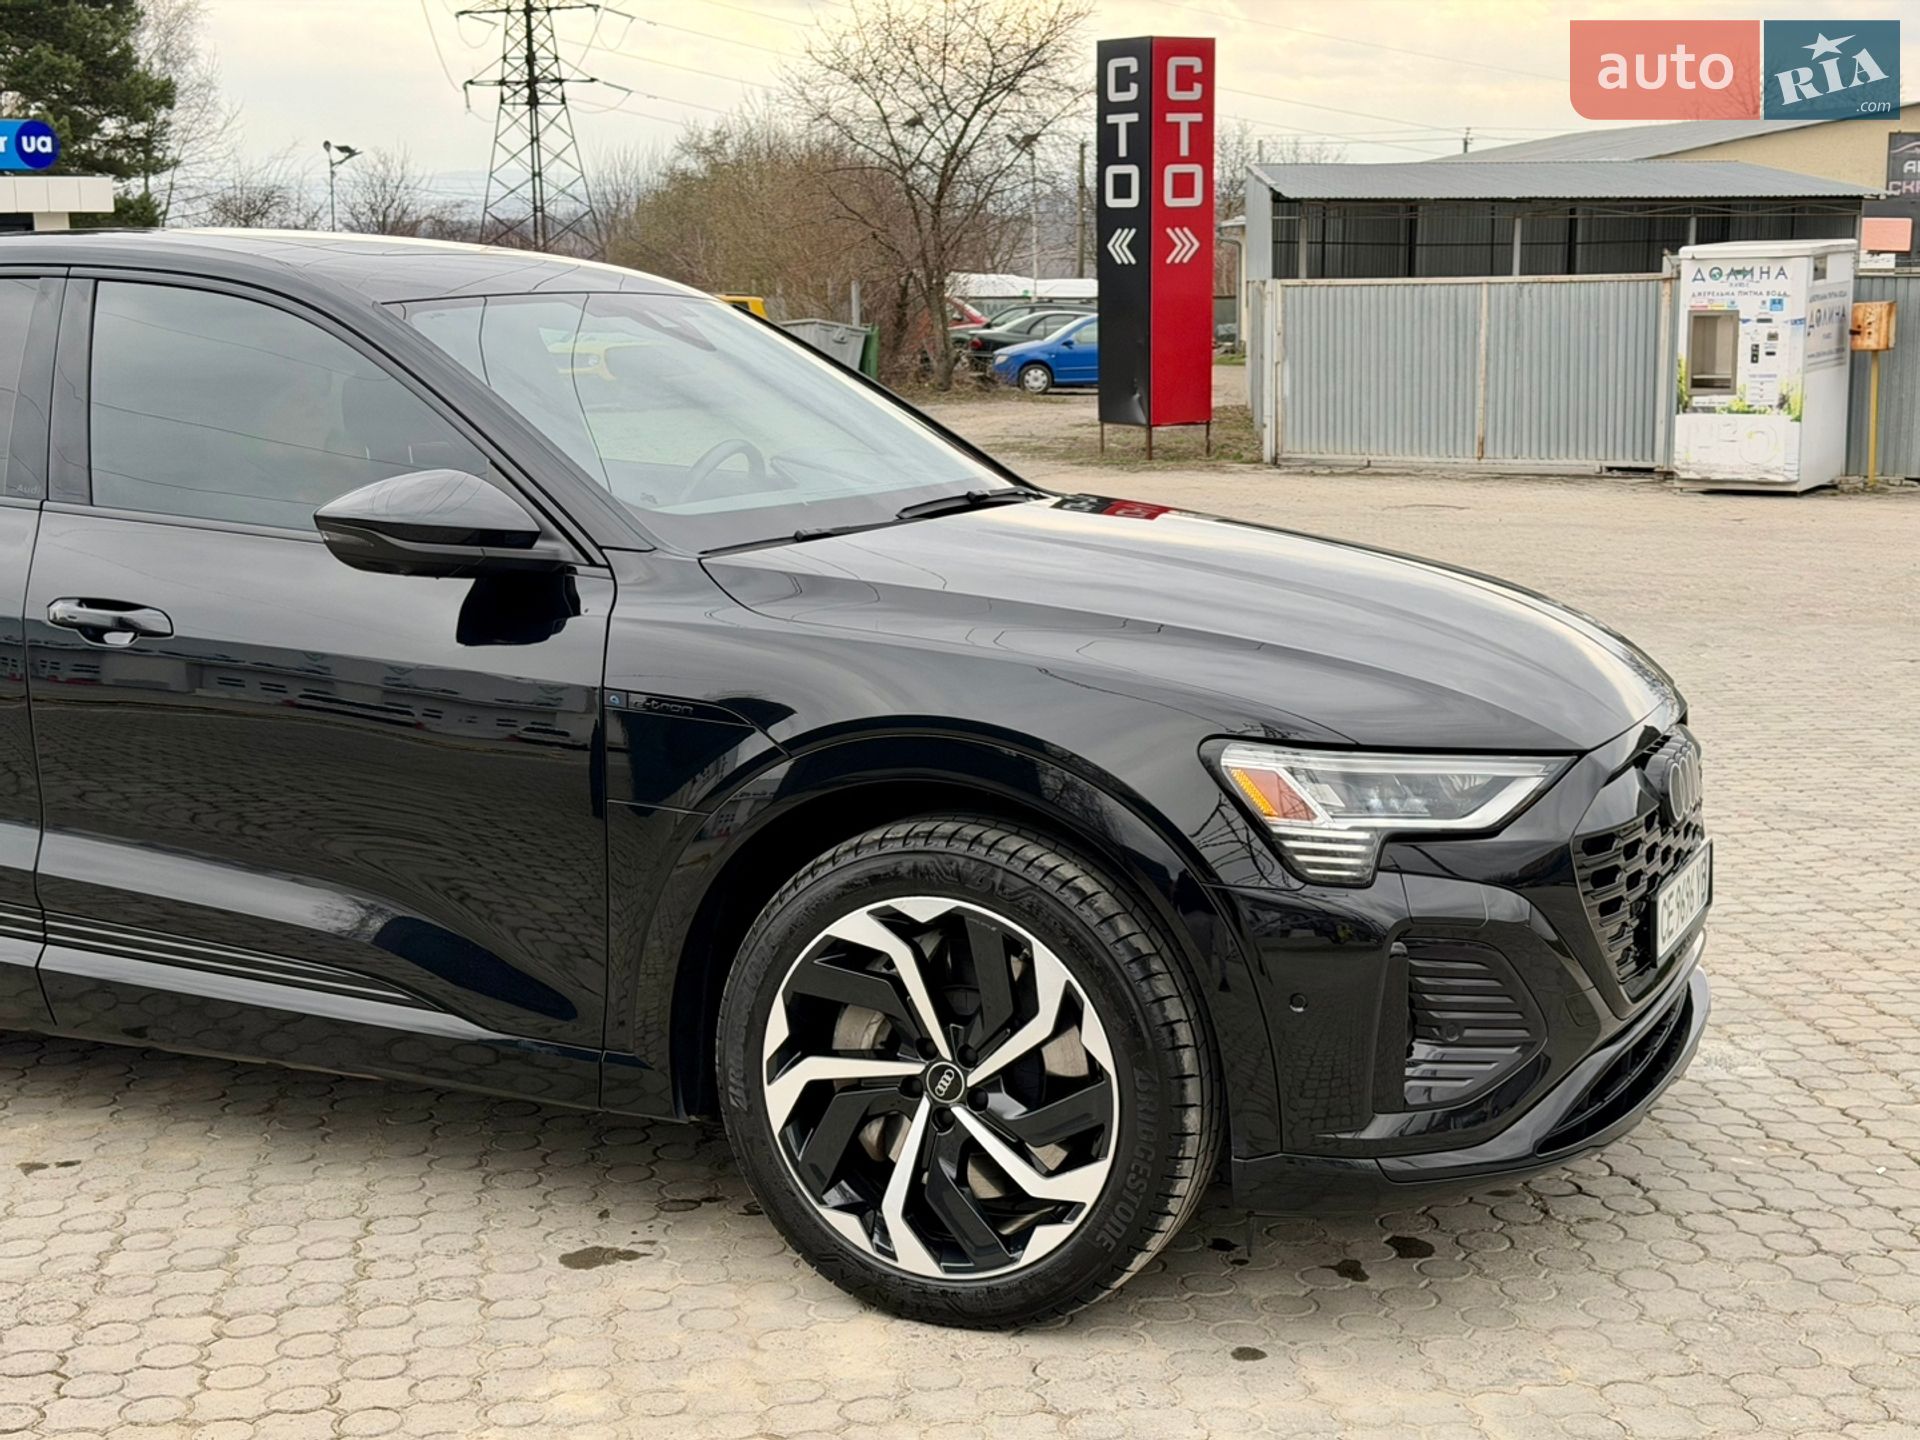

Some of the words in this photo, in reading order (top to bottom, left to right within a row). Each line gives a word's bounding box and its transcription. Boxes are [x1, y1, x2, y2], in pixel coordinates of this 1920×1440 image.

[21, 135, 52, 153] ua
[1105, 56, 1139, 208] СТО
[1164, 56, 1203, 208] СТО
[1095, 1066, 1159, 1252] BRIDGESTONE
